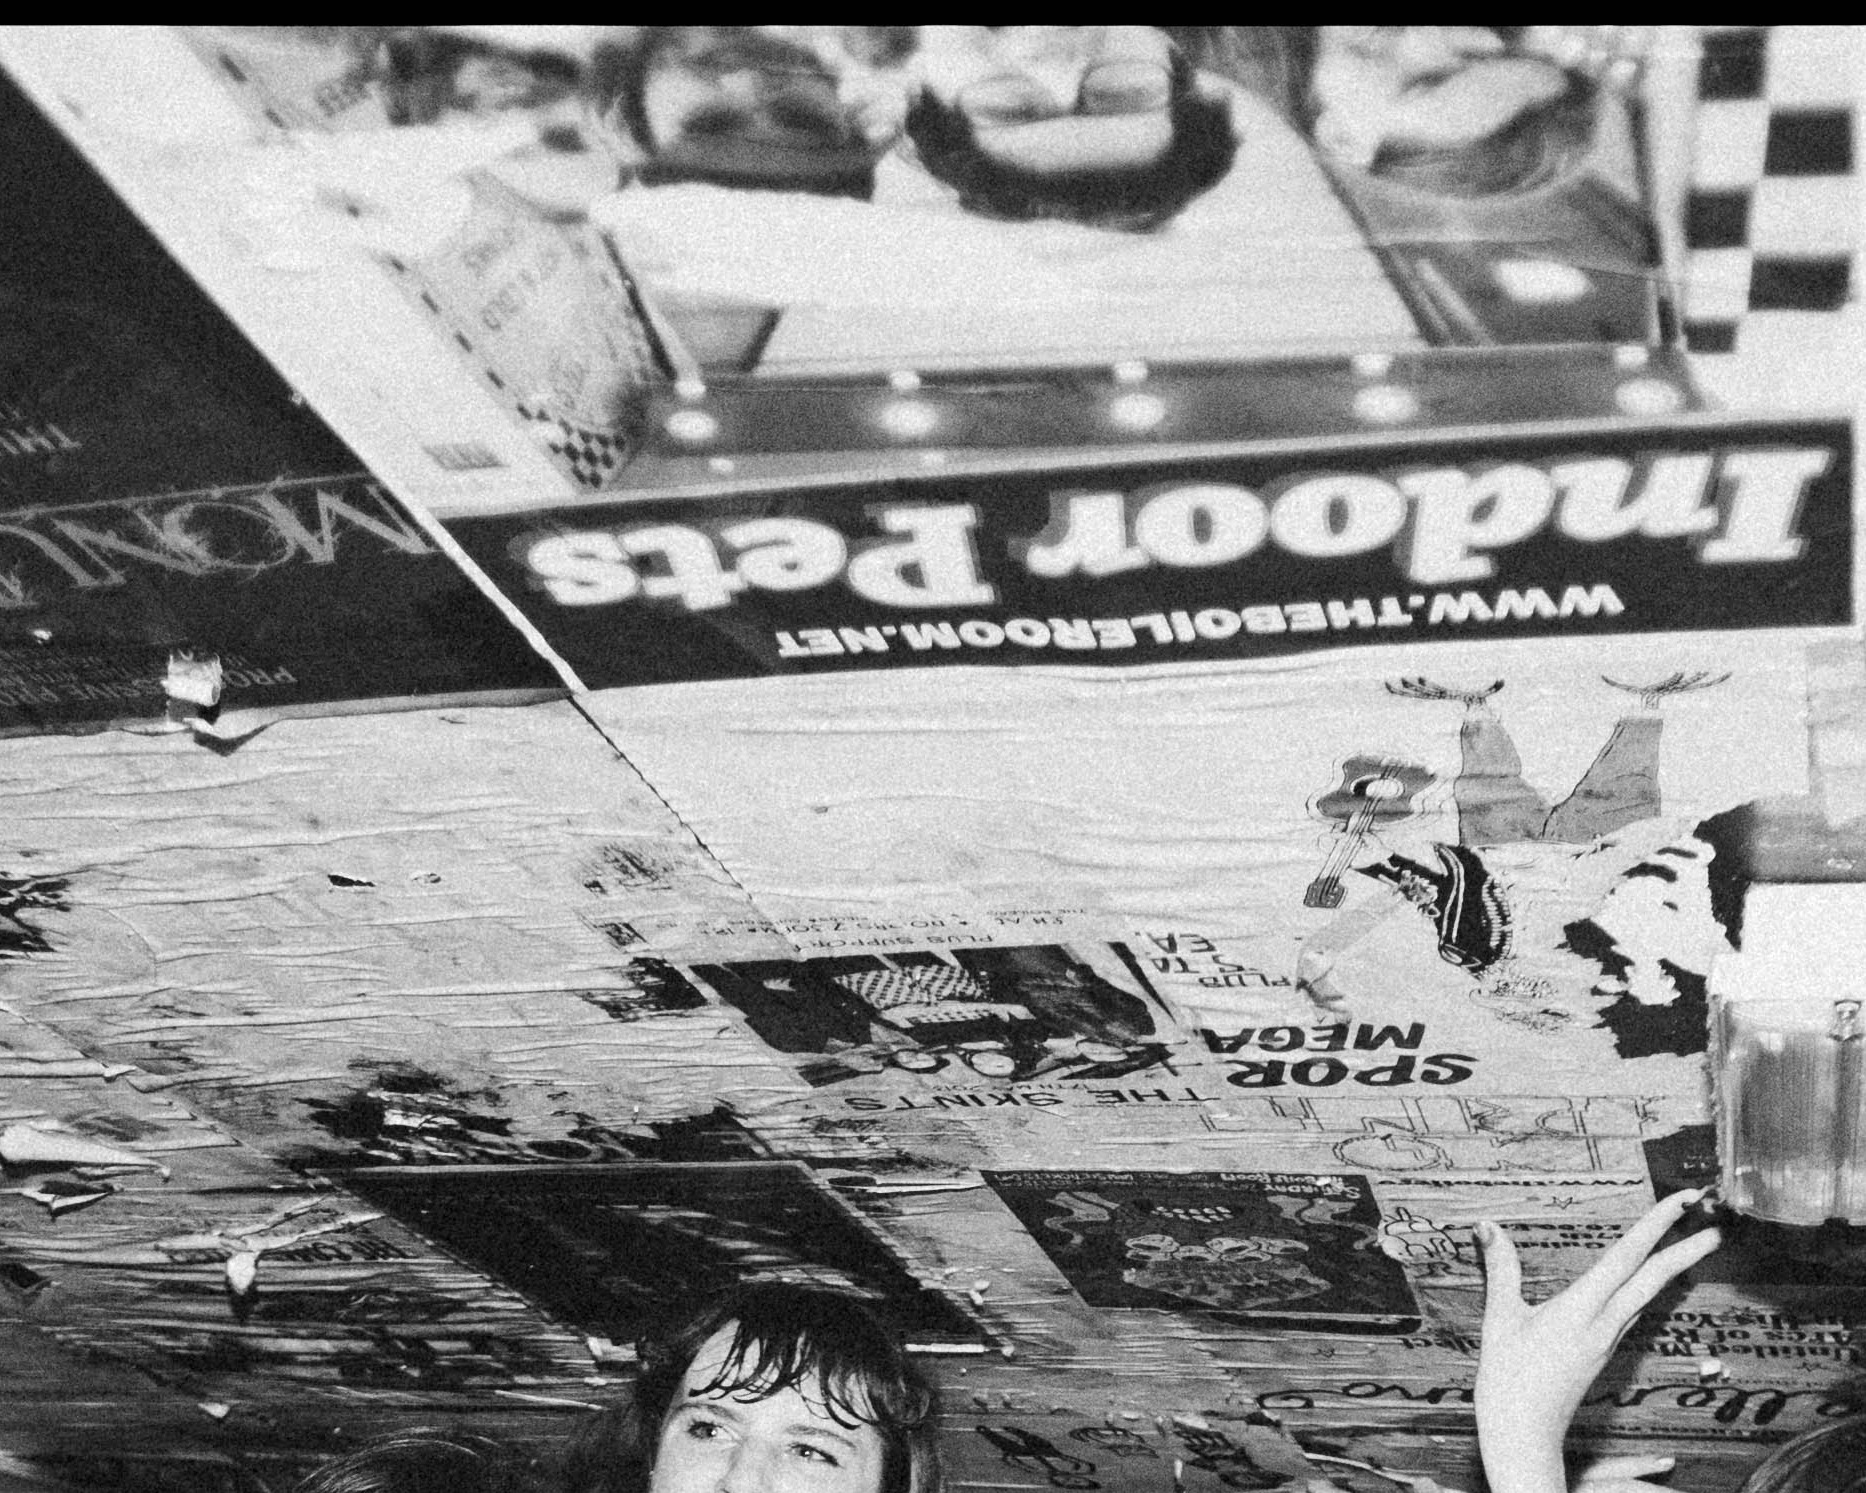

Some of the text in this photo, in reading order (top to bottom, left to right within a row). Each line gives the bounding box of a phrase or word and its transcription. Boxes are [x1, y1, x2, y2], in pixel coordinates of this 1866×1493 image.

[523, 448, 1831, 616] Indoor Pets
[771, 582, 1625, 660] WWW.THEBOILEROOM.NET
[1197, 1022, 1426, 1054] MEGA
[1221, 1053, 1479, 1089] SPOR
[843, 1087, 1222, 1113] THE SKINTS
